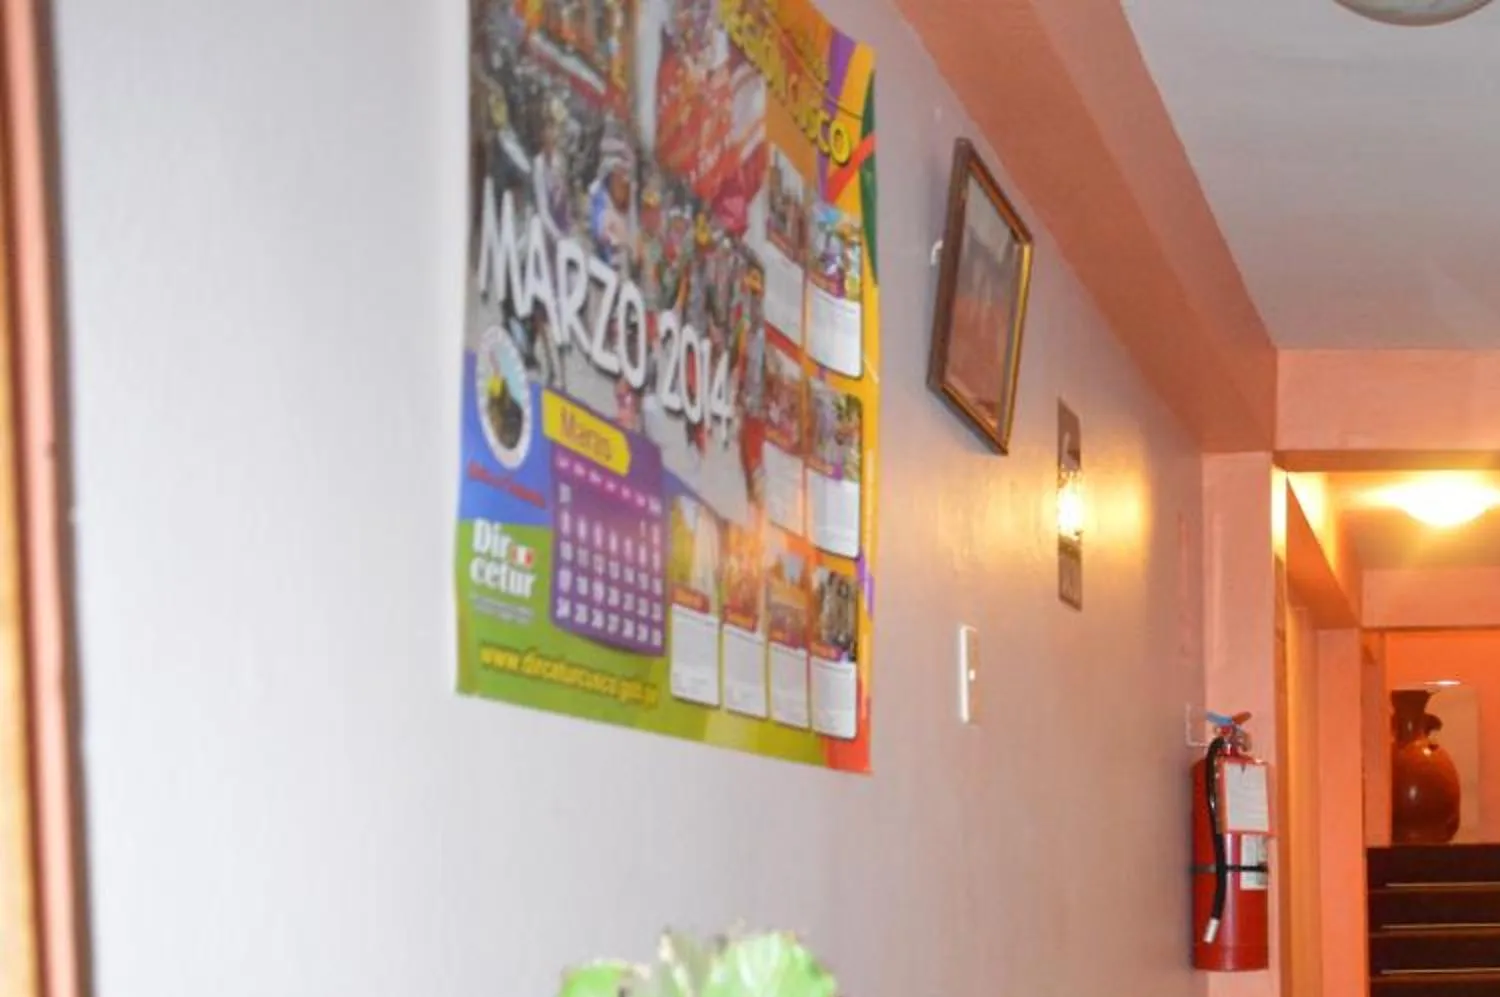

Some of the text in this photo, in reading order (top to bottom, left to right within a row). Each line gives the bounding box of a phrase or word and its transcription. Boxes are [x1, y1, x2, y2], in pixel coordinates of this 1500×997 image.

[479, 177, 735, 440] MARZO 2014
[472, 517, 512, 559] Dir
